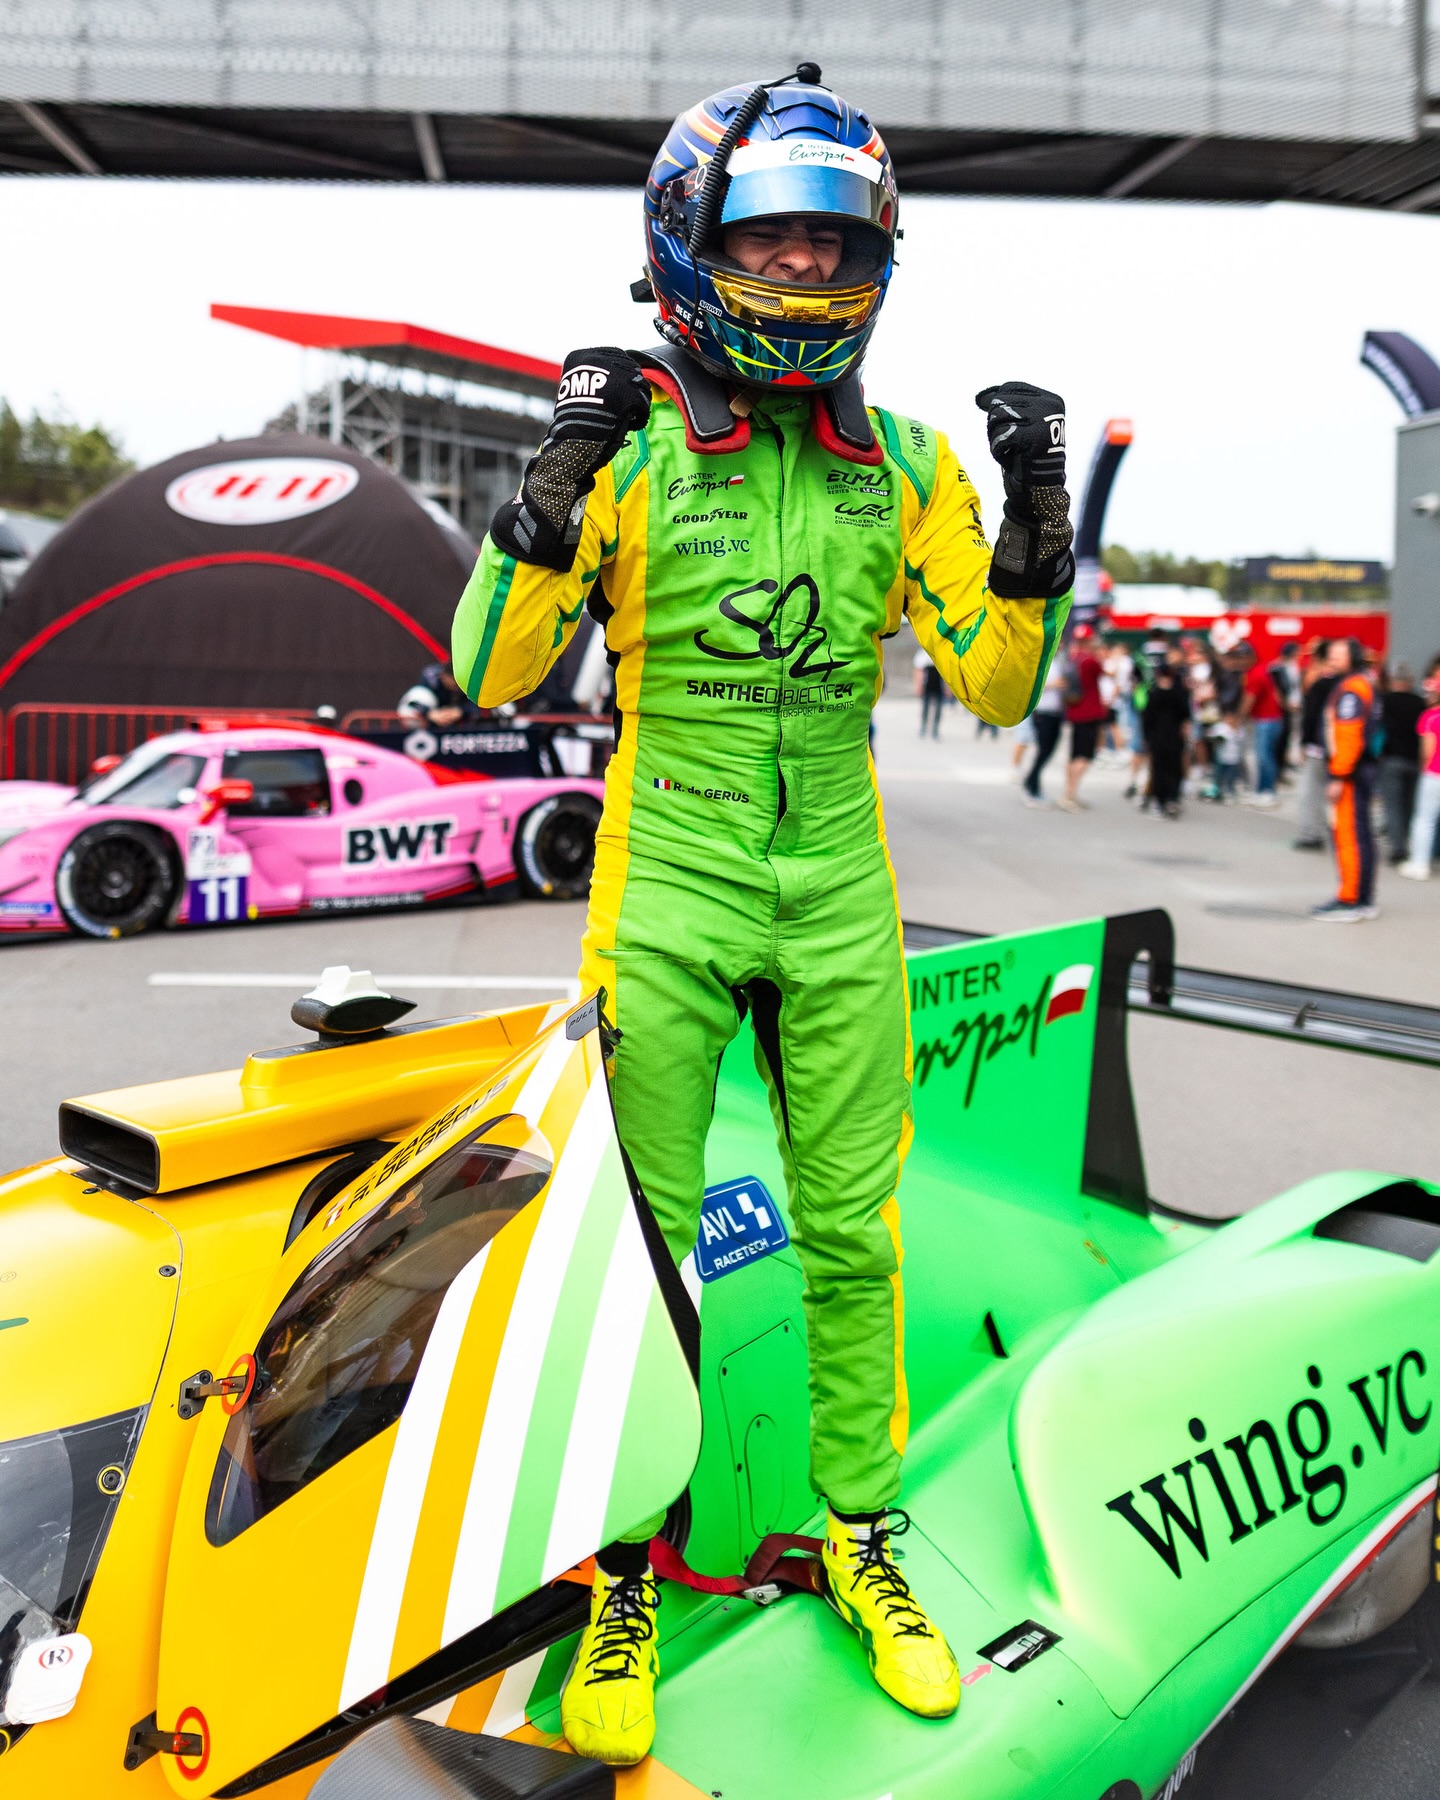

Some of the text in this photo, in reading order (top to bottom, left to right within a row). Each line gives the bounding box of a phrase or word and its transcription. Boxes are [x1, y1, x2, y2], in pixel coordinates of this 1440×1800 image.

[557, 371, 608, 401] OMP
[667, 477, 731, 501] Europol
[687, 472, 714, 481] INTER
[871, 488, 889, 497] MANS
[672, 508, 748, 524] GOODYEAR
[834, 501, 895, 522] WEC
[674, 535, 750, 558] wing.vc
[818, 705, 825, 713] &
[826, 700, 854, 713] EVENTS
[673, 781, 750, 804] R. de GERUS
[347, 821, 453, 866] BWT
[198, 876, 240, 922] 11
[912, 962, 1002, 1012] INTER
[568, 1006, 595, 1030] PULL
[347, 1184, 371, 1211] R.
[374, 1148, 414, 1189] DE
[415, 1074, 511, 1156] GERUS
[383, 1104, 460, 1171] GARG
[700, 1206, 747, 1246] AVL
[713, 1237, 770, 1271] RACETECH
[1105, 1349, 1433, 1580] wing.vc
